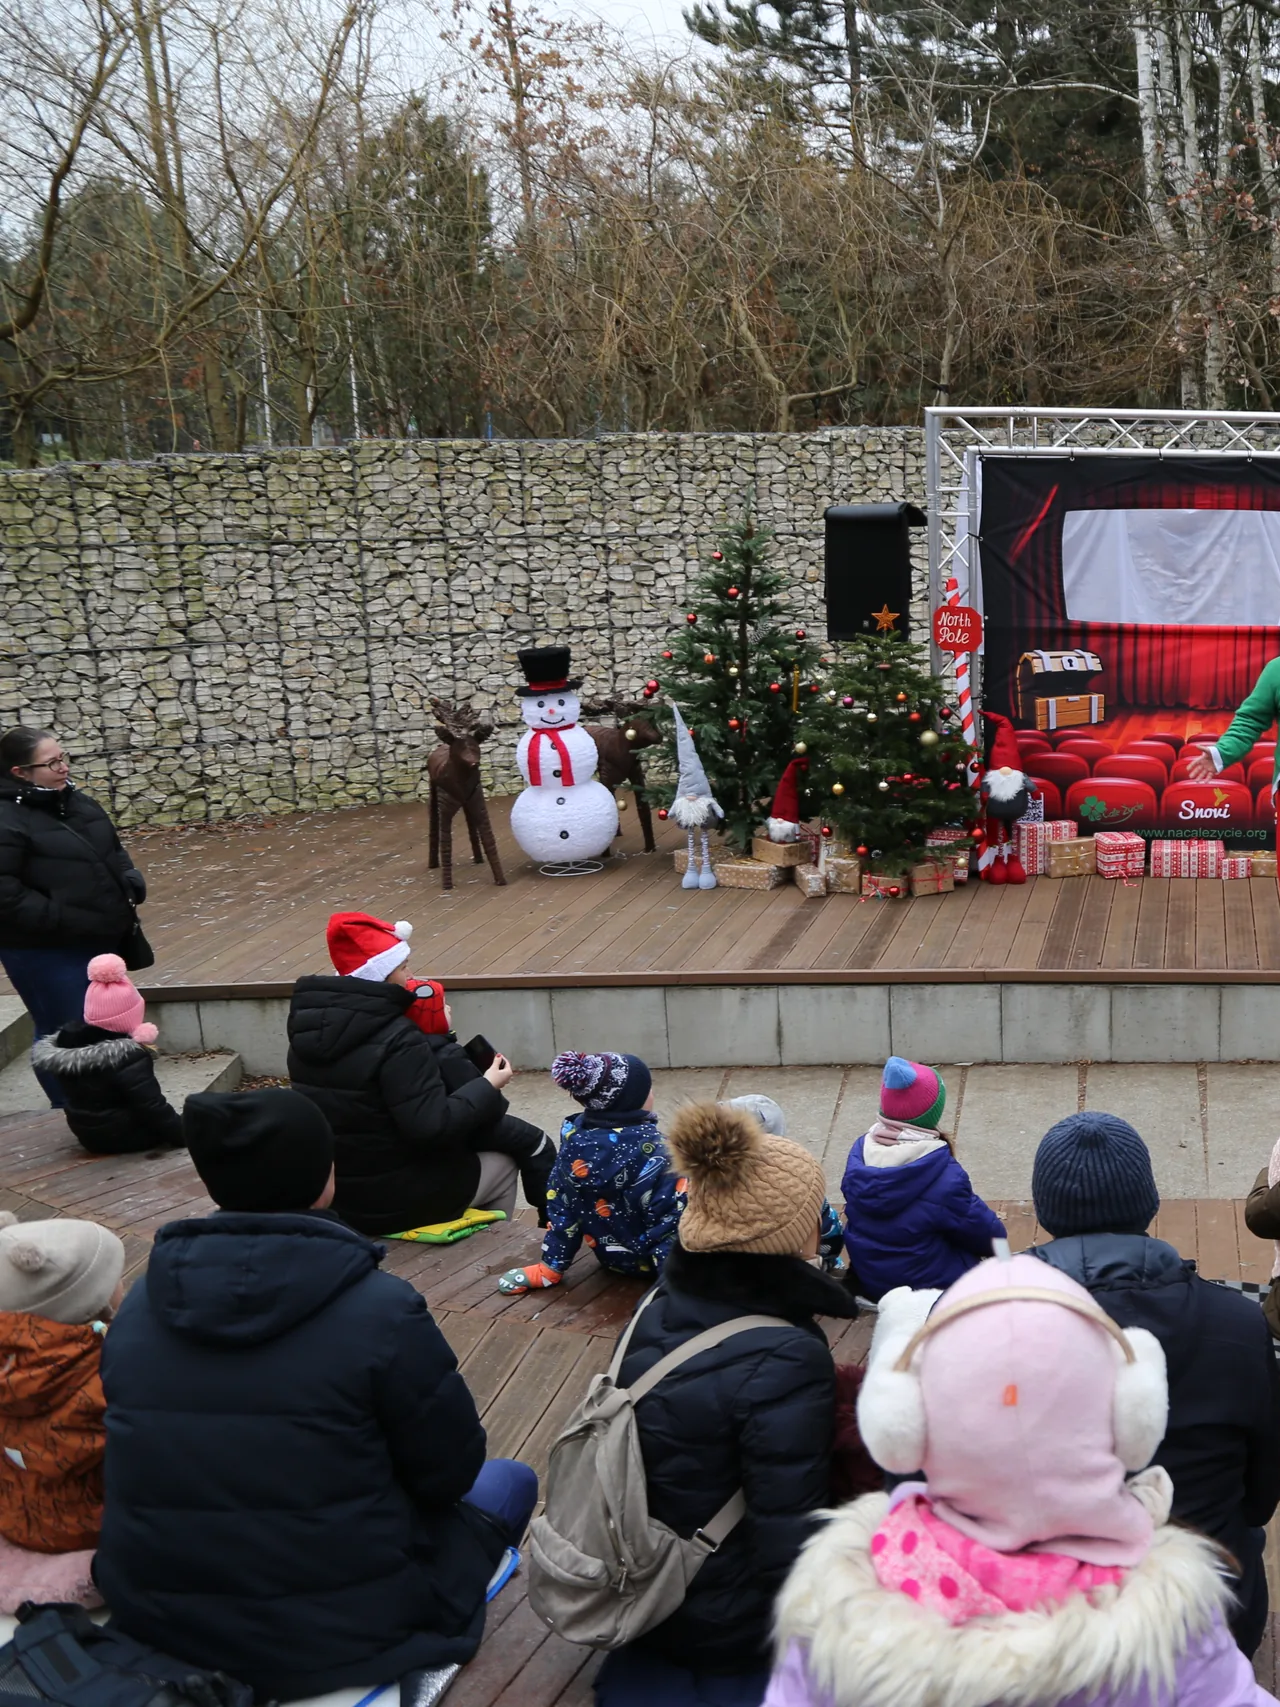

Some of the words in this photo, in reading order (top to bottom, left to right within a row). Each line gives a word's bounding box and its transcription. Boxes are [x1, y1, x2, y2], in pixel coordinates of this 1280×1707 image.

[938, 612, 971, 627] North
[938, 626, 970, 644] Pole
[1178, 799, 1231, 820] Snovi
[1133, 827, 1267, 840] www.nacalezycie.org
